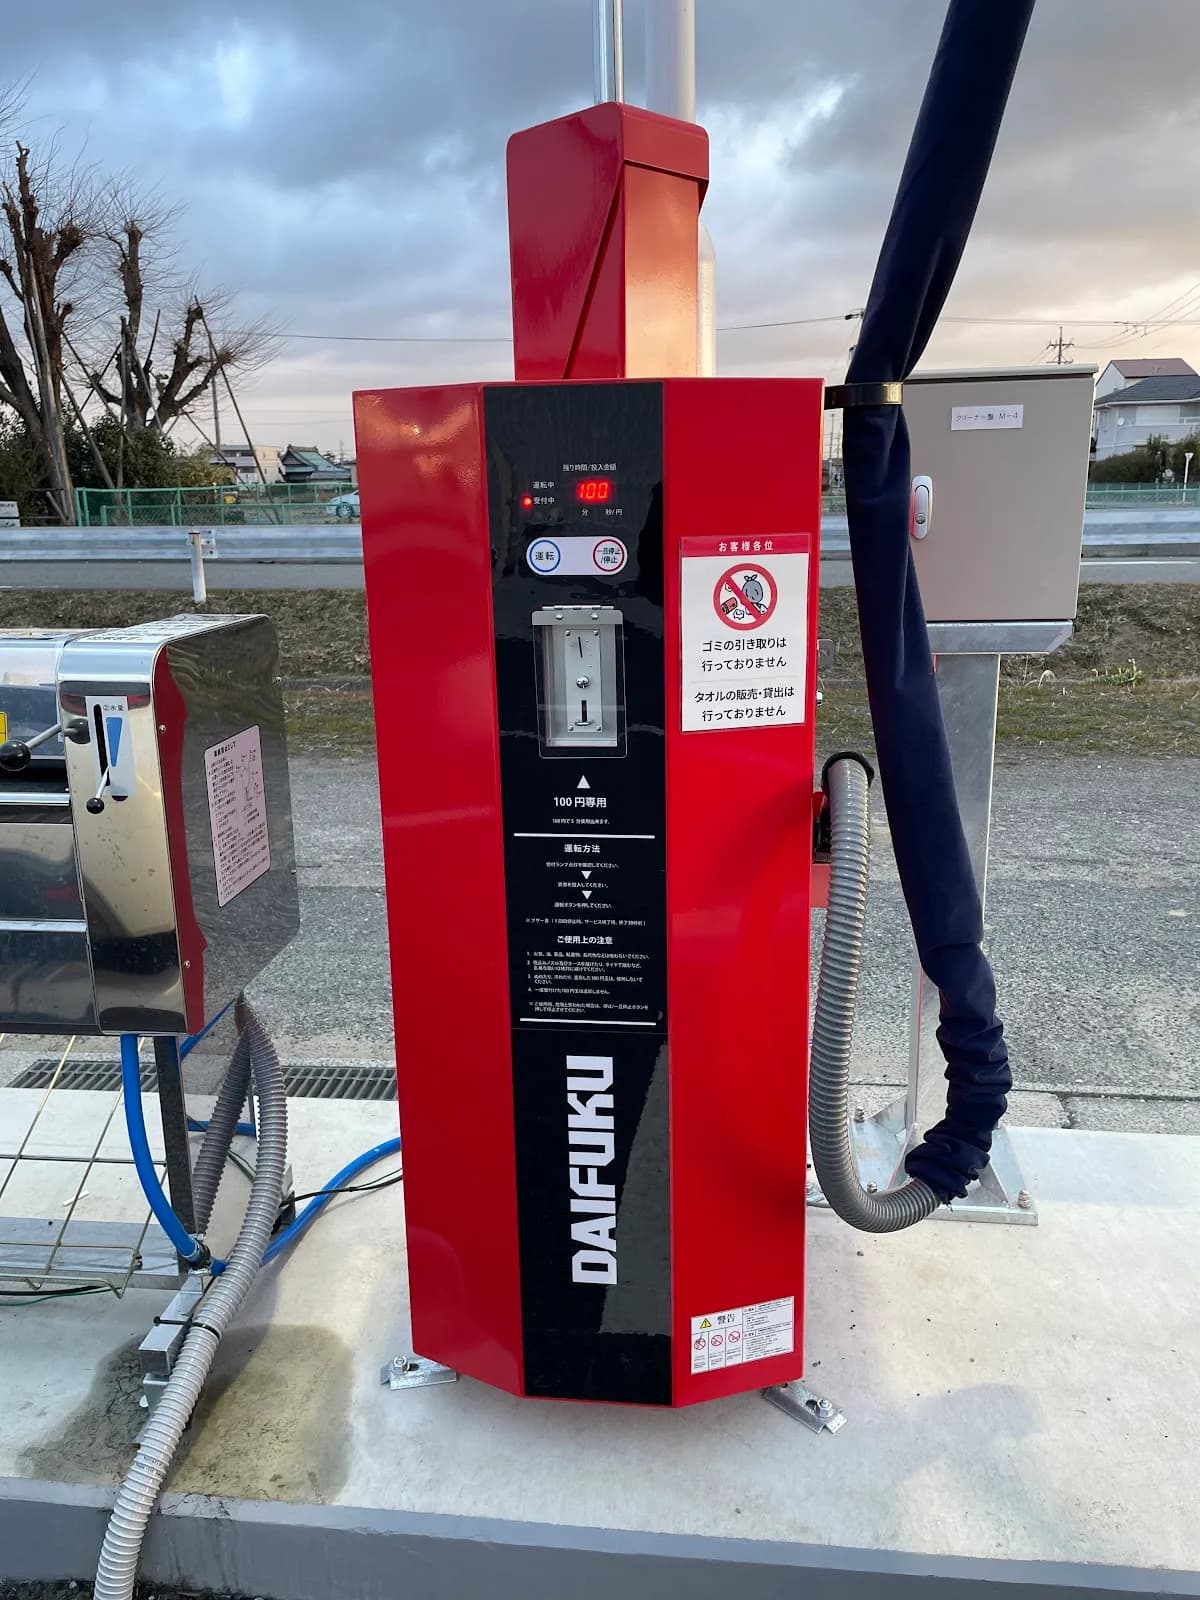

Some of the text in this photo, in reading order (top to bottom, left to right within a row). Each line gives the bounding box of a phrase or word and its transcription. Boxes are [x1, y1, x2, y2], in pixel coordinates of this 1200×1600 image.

[578, 482, 609, 499] 100
[533, 497, 555, 505] 受付中
[719, 541, 774, 552] お客様各位
[535, 551, 555, 561] 運転
[702, 637, 787, 652] ゴミの引き取りは
[701, 656, 787, 672] 行っておりません
[694, 686, 795, 703] タオルの販売・貸出は
[701, 705, 786, 722] 行っておりません
[564, 844, 600, 853] 運転方法
[557, 936, 613, 945] ご使用上の注意
[566, 1055, 617, 1285] DAIFUKU
